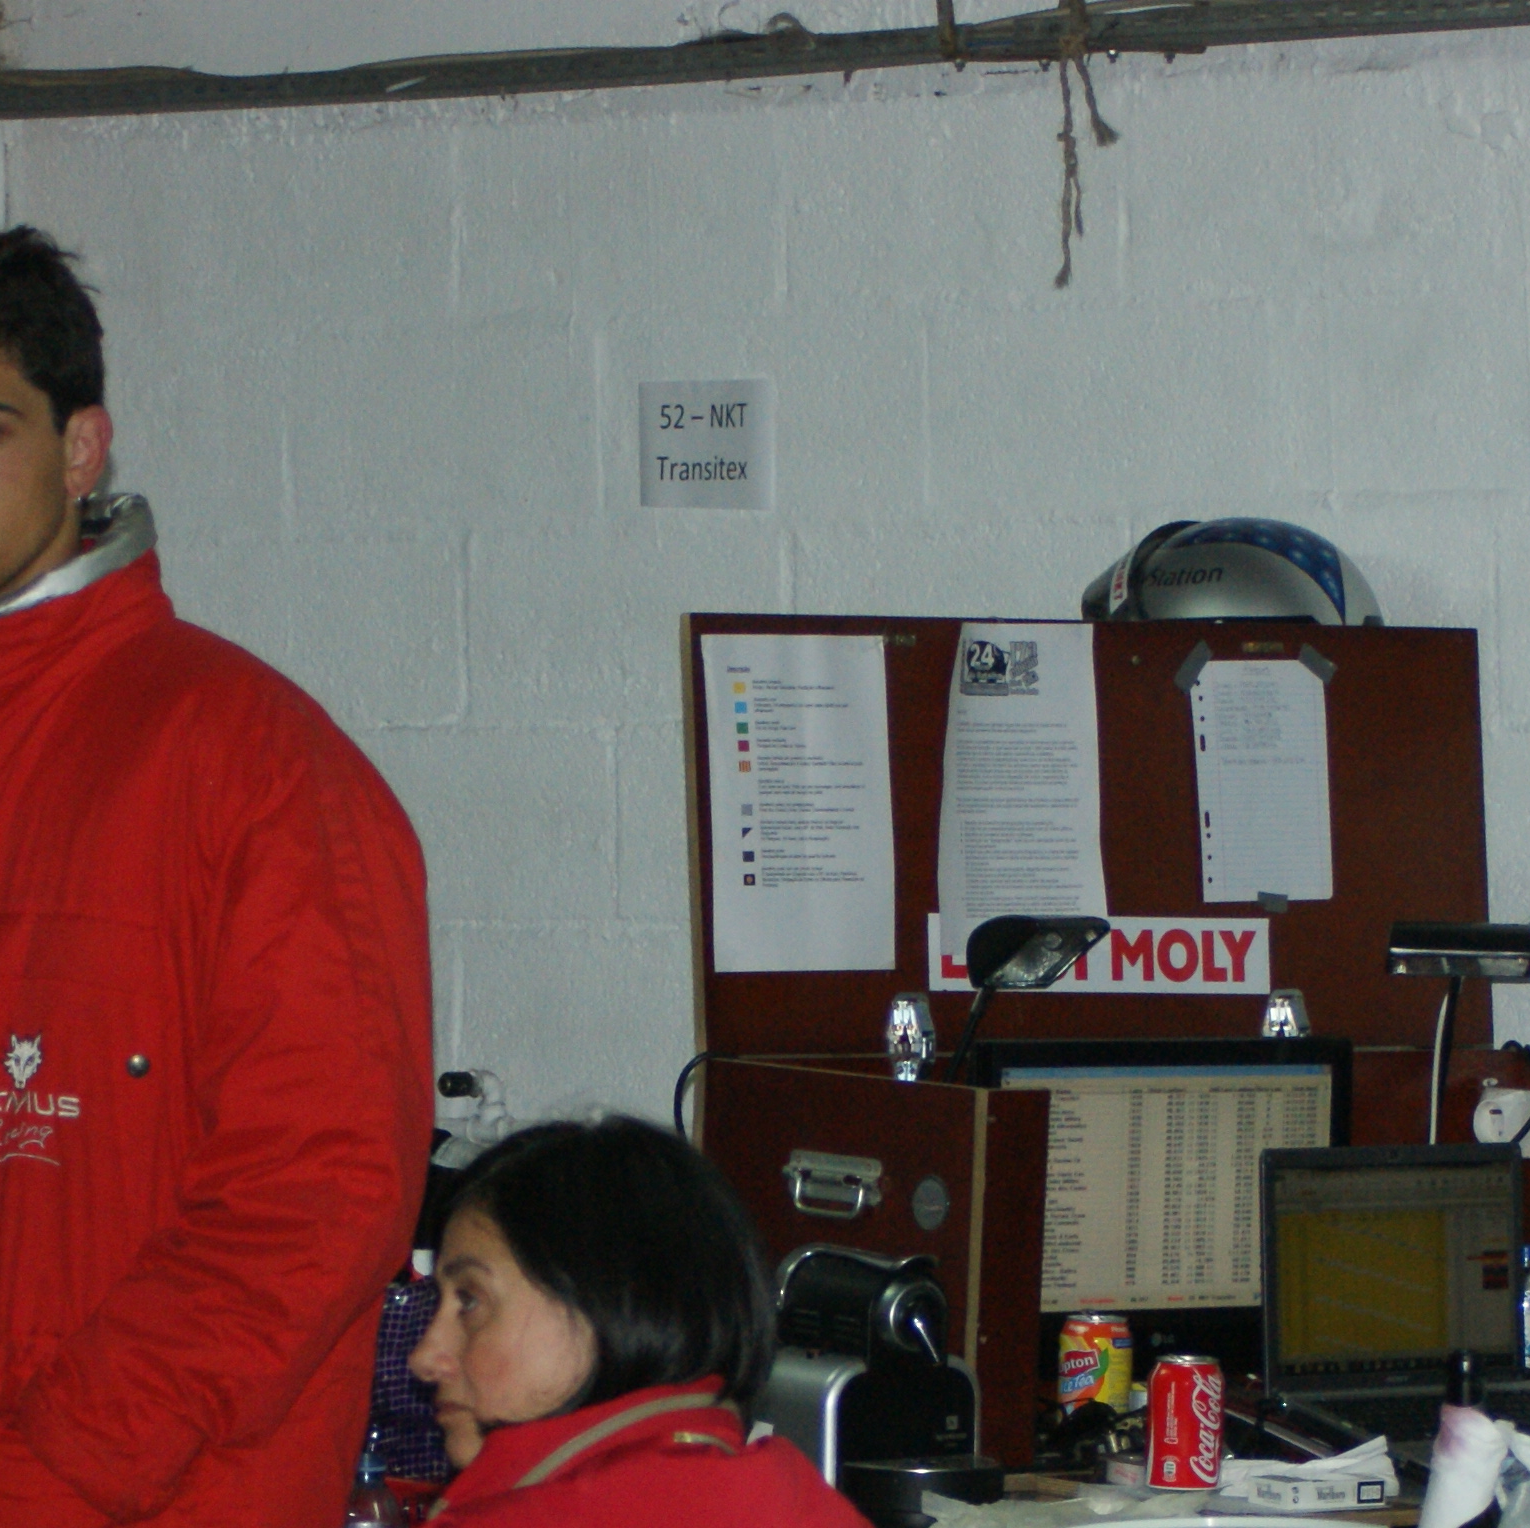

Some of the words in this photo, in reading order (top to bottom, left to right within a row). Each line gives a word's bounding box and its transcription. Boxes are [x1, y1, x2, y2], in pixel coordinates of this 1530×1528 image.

[659, 404, 685, 429] 52
[710, 403, 747, 428] NKT
[656, 456, 748, 481] Transitex
[1142, 565, 1223, 587] Station
[970, 643, 995, 671] 24
[1111, 928, 1257, 983] MOLY
